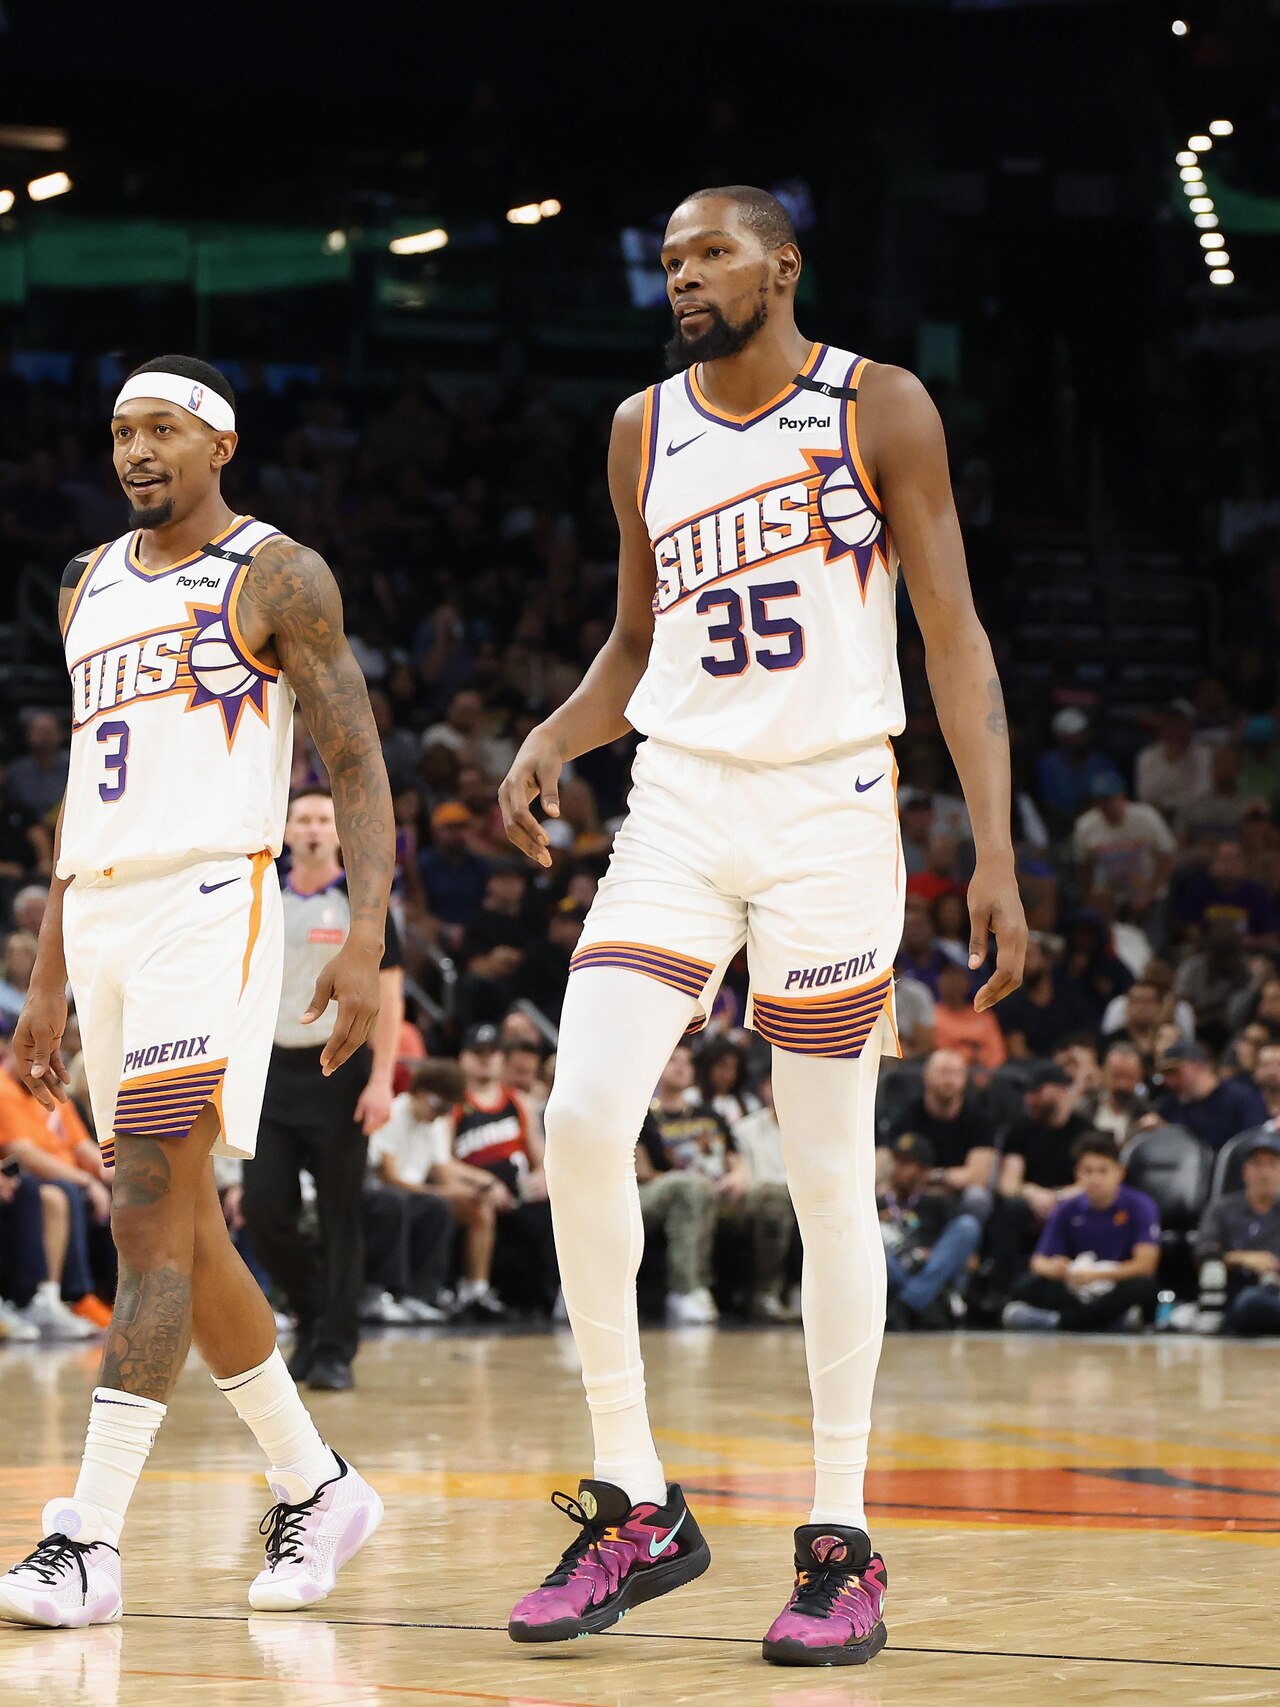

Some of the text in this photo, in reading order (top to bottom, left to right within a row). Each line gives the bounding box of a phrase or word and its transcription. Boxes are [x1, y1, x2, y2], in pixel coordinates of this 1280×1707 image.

[819, 384, 832, 396] AL
[779, 416, 831, 432] PayPal
[655, 482, 810, 611] SUNS
[176, 576, 221, 590] PayPal
[696, 580, 805, 678] 35
[71, 632, 183, 725] UNS
[96, 720, 130, 802] 3
[784, 948, 878, 990] PHOENIX
[123, 1035, 211, 1073] PHOENIX
